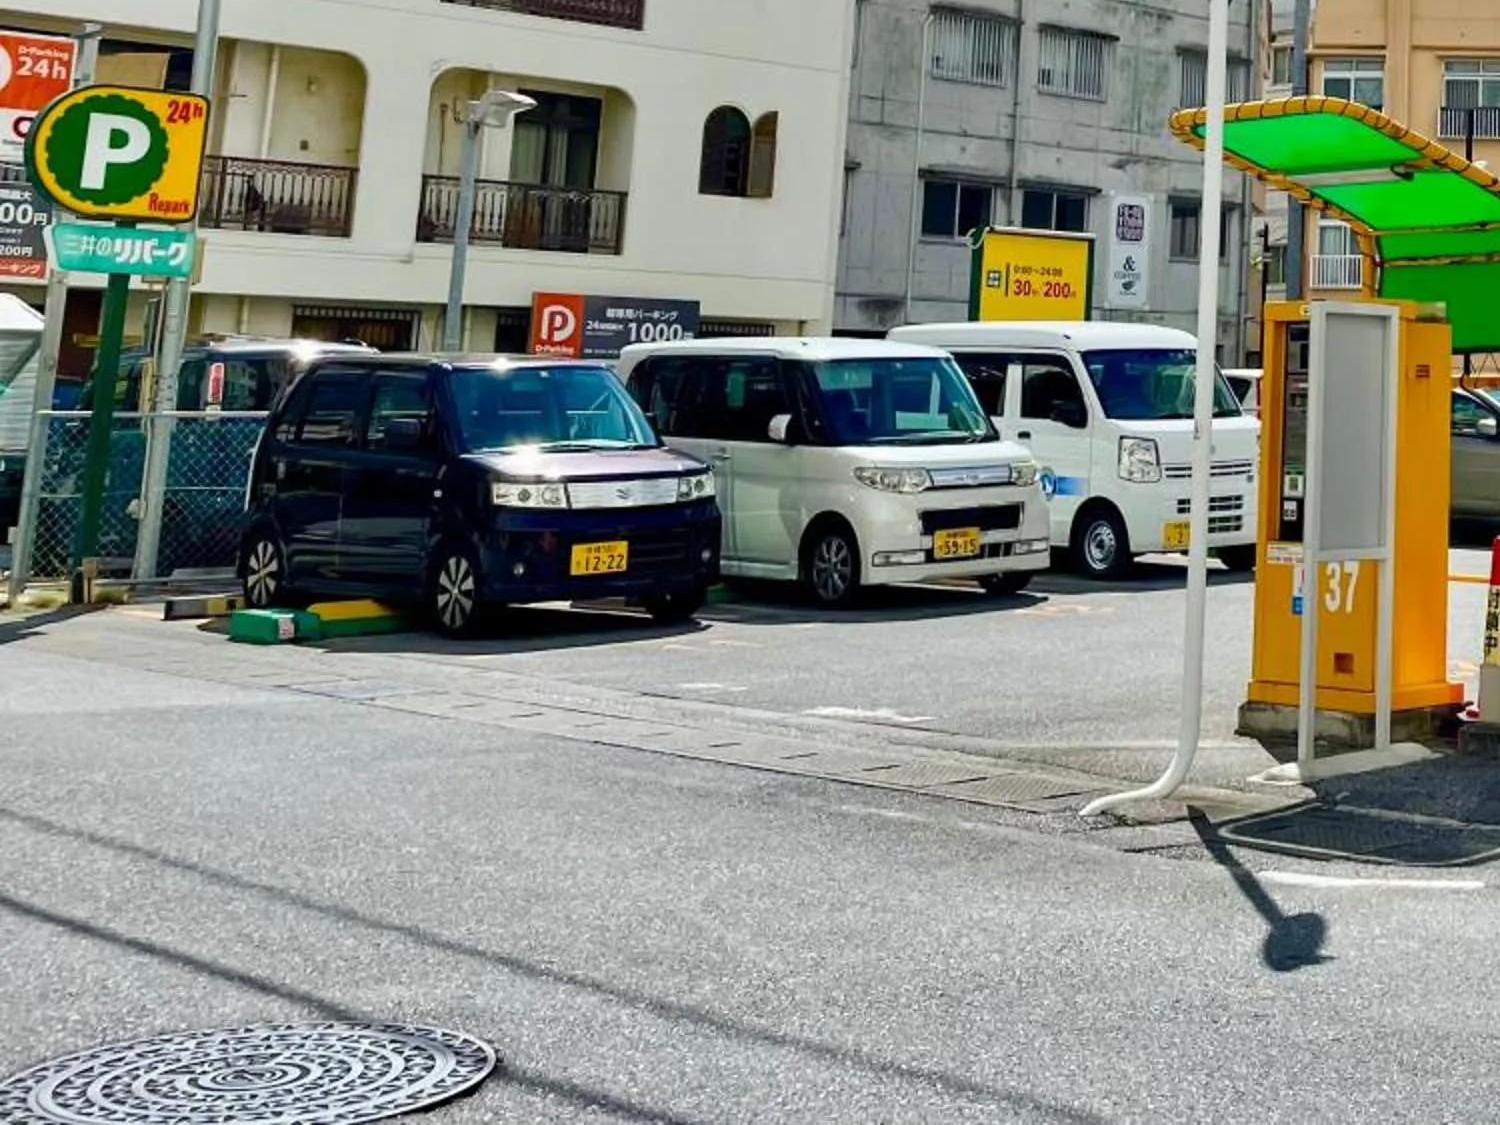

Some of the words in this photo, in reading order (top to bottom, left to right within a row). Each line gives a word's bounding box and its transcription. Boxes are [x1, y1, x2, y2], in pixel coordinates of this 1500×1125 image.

[16, 56, 67, 80] 24h
[167, 101, 203, 124] 24h
[80, 112, 151, 191] P
[149, 192, 190, 214] Repark
[62, 234, 188, 267] 三井のリパーク
[1123, 255, 1136, 272] &
[1324, 561, 1360, 615] 37
